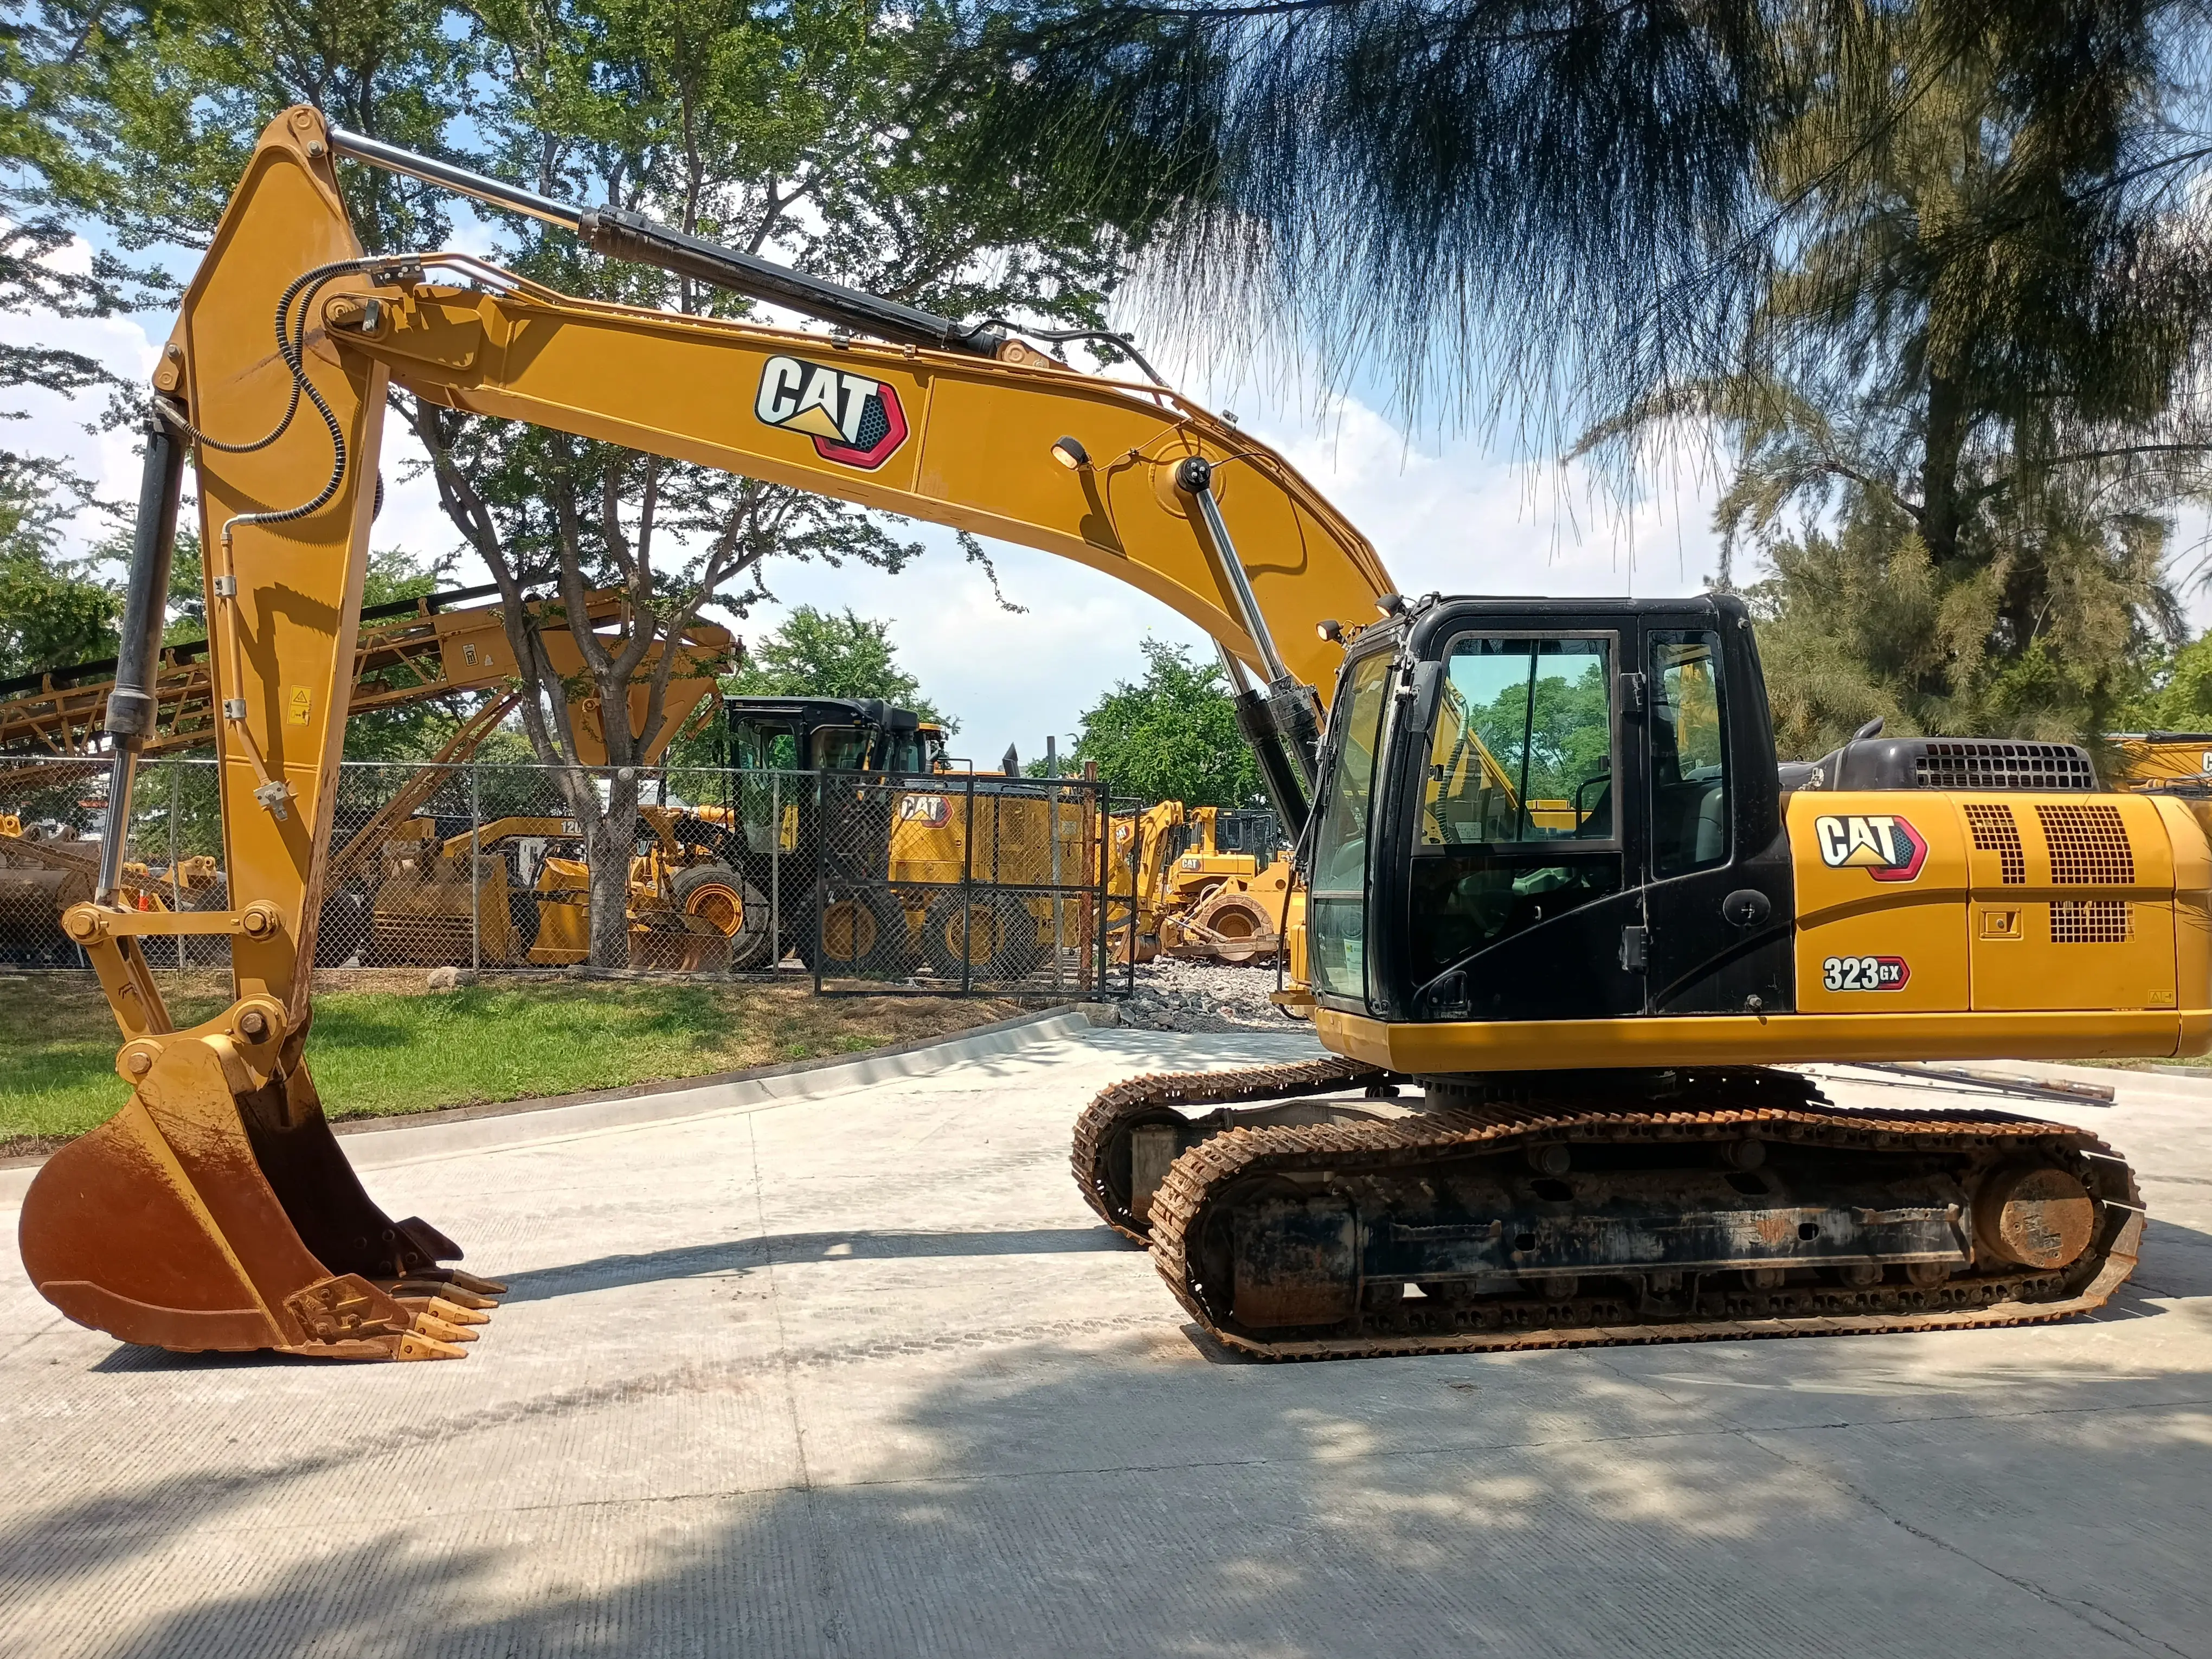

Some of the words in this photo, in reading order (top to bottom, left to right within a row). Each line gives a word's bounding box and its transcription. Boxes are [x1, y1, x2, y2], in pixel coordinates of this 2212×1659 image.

[757, 356, 879, 444] CAT
[901, 796, 941, 820] CAT
[1816, 816, 1896, 866] CAT
[1182, 859, 1197, 869] CAT
